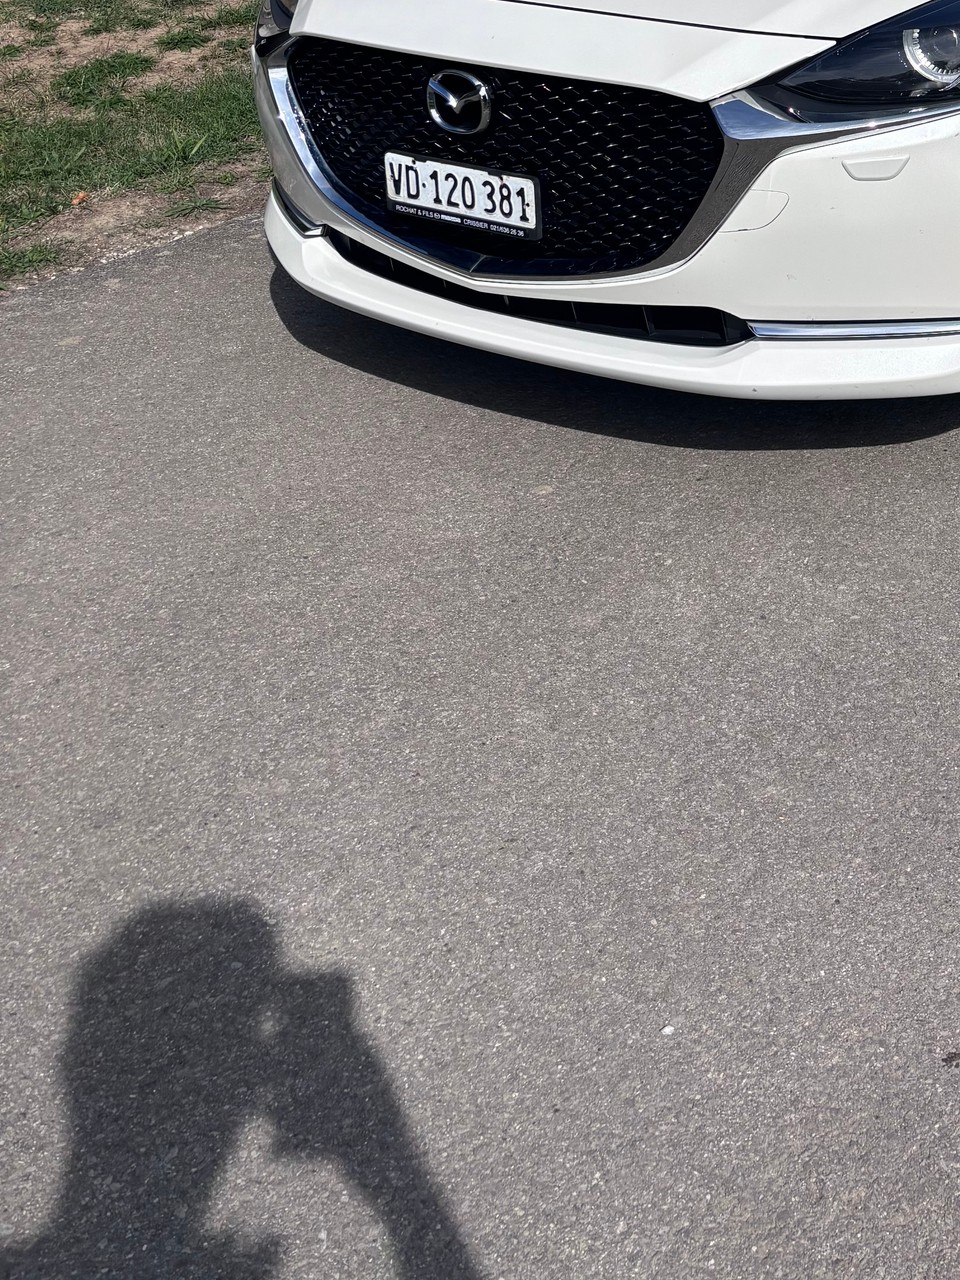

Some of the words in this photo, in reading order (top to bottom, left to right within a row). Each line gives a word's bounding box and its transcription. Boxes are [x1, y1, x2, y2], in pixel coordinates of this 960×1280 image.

[395, 204, 417, 215] ROCHAT
[422, 210, 434, 218] FILS
[481, 180, 530, 223] 381
